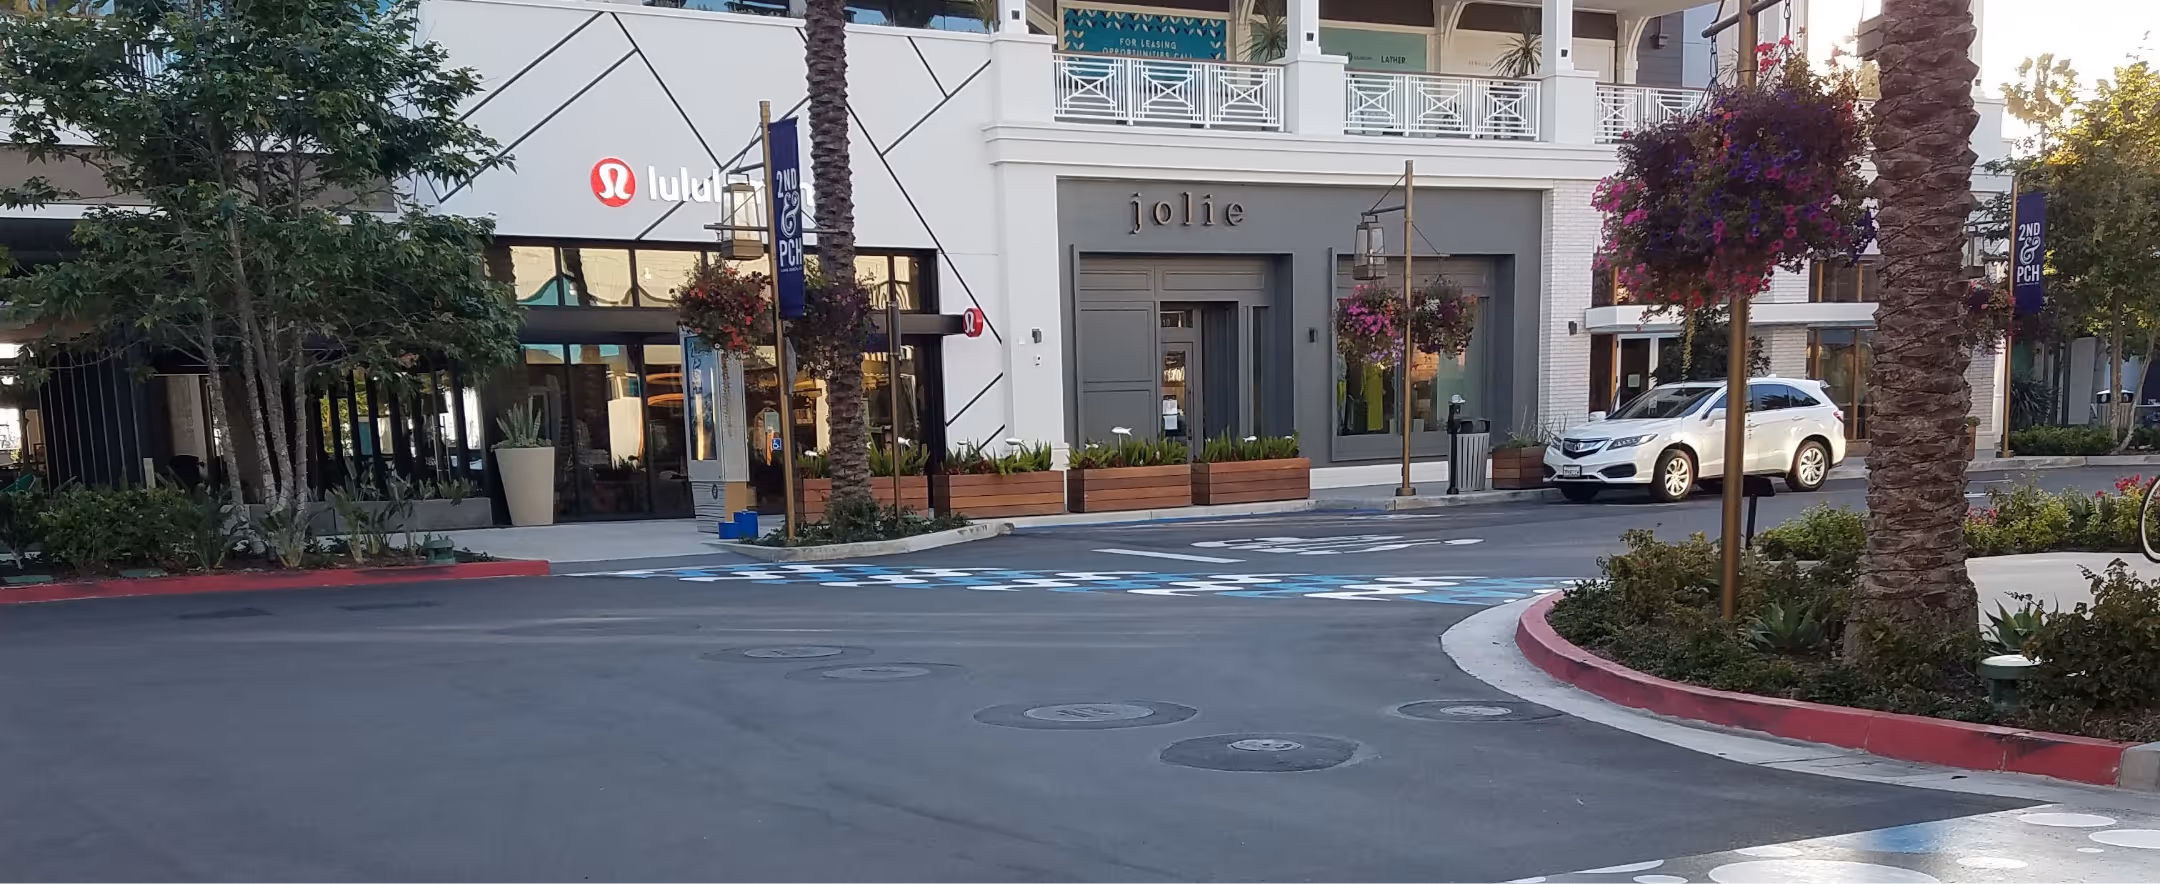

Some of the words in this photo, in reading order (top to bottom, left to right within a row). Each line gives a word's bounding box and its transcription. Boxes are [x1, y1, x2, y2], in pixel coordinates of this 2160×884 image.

[1119, 38, 1136, 46] FOR
[1141, 39, 1177, 49] LEASING
[648, 165, 815, 206] lululn
[776, 167, 798, 199] 2ND
[781, 190, 800, 238] &
[1129, 191, 1244, 235] jolie
[2018, 222, 2040, 241] 2ND
[778, 237, 802, 267] PCH
[2020, 236, 2041, 265] &
[2016, 264, 2040, 282] PCH
